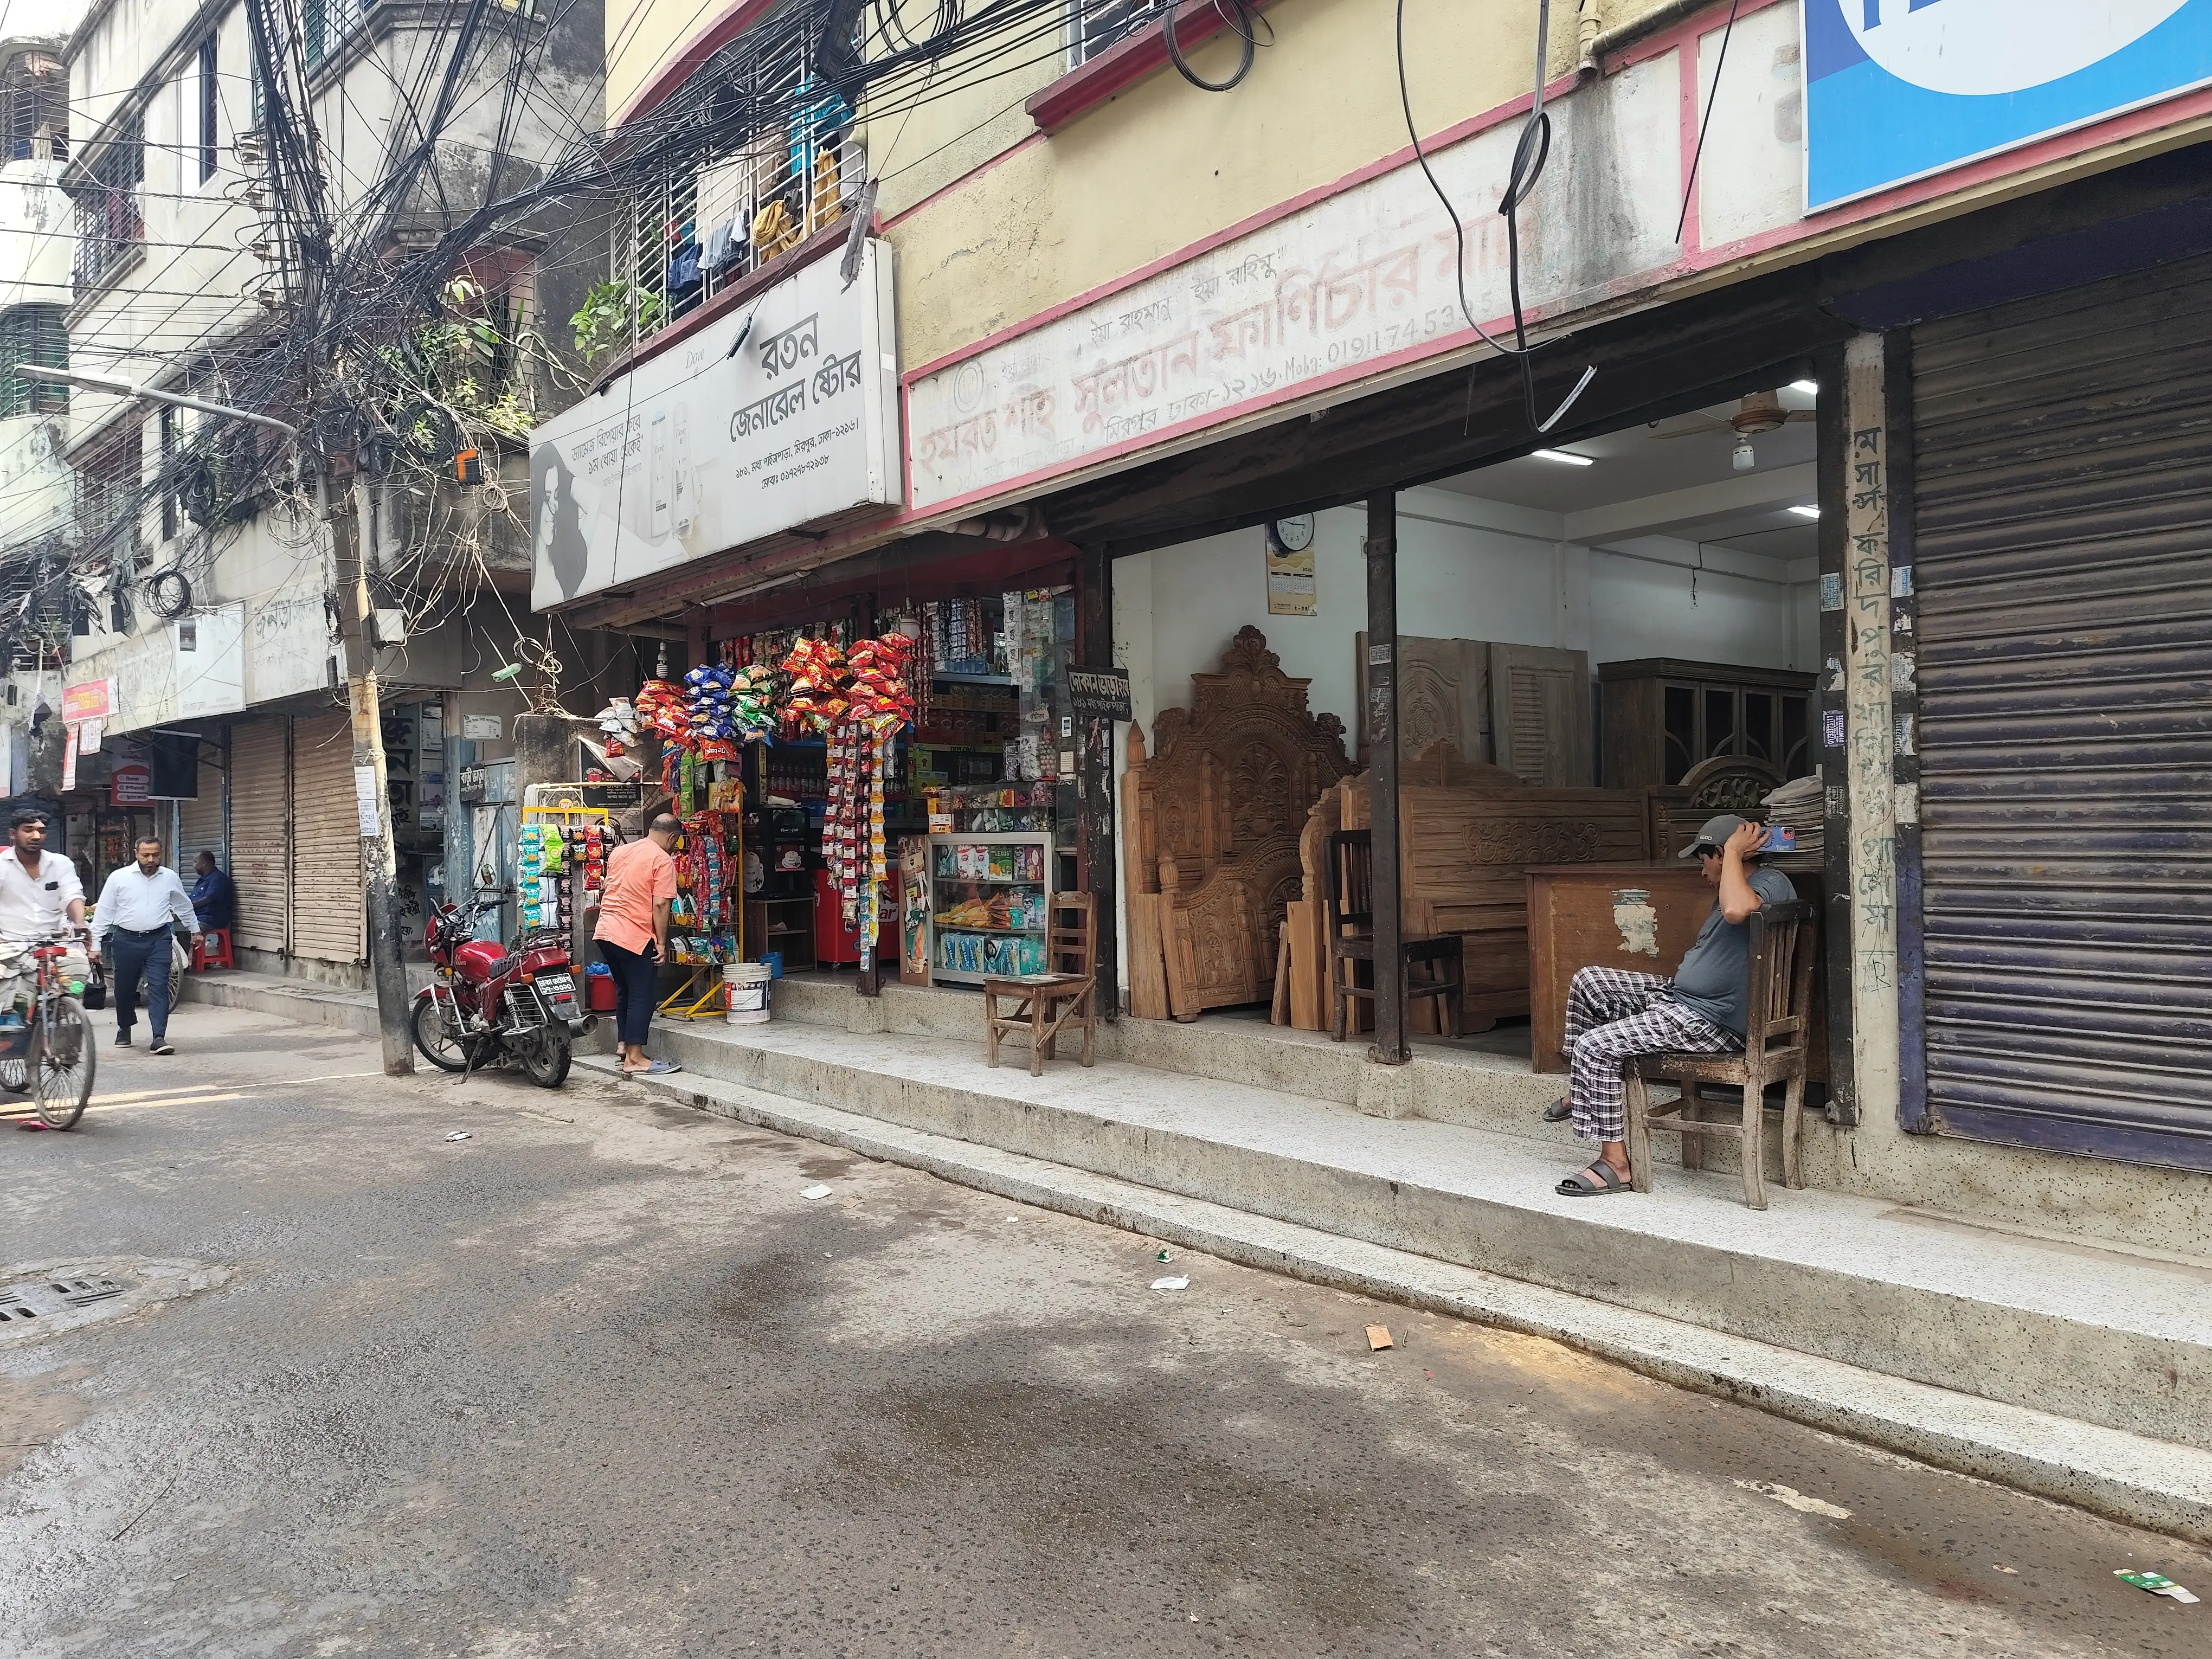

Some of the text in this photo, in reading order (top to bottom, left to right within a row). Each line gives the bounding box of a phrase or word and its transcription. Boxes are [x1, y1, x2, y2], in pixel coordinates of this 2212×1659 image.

[685, 348, 705, 369] Dove
[760, 312, 819, 381] রতন
[730, 350, 861, 442] জেনারেল ষ্টোর
[1072, 331, 1200, 435] সুলতান
[571, 438, 595, 461] ড্যামেজ
[597, 422, 624, 449] রিপেয়ার
[1105, 407, 1159, 444] মিরপুর
[588, 458, 599, 474] ১ম
[601, 448, 618, 468] ধোয়া
[736, 466, 750, 479] ১৮১,
[751, 459, 762, 472] মধ্য
[794, 437, 817, 455] মিরপুর,
[1068, 672, 1099, 695] দোকান
[1097, 674, 1120, 701] ভাড়া
[537, 979, 553, 987] ঢাকা
